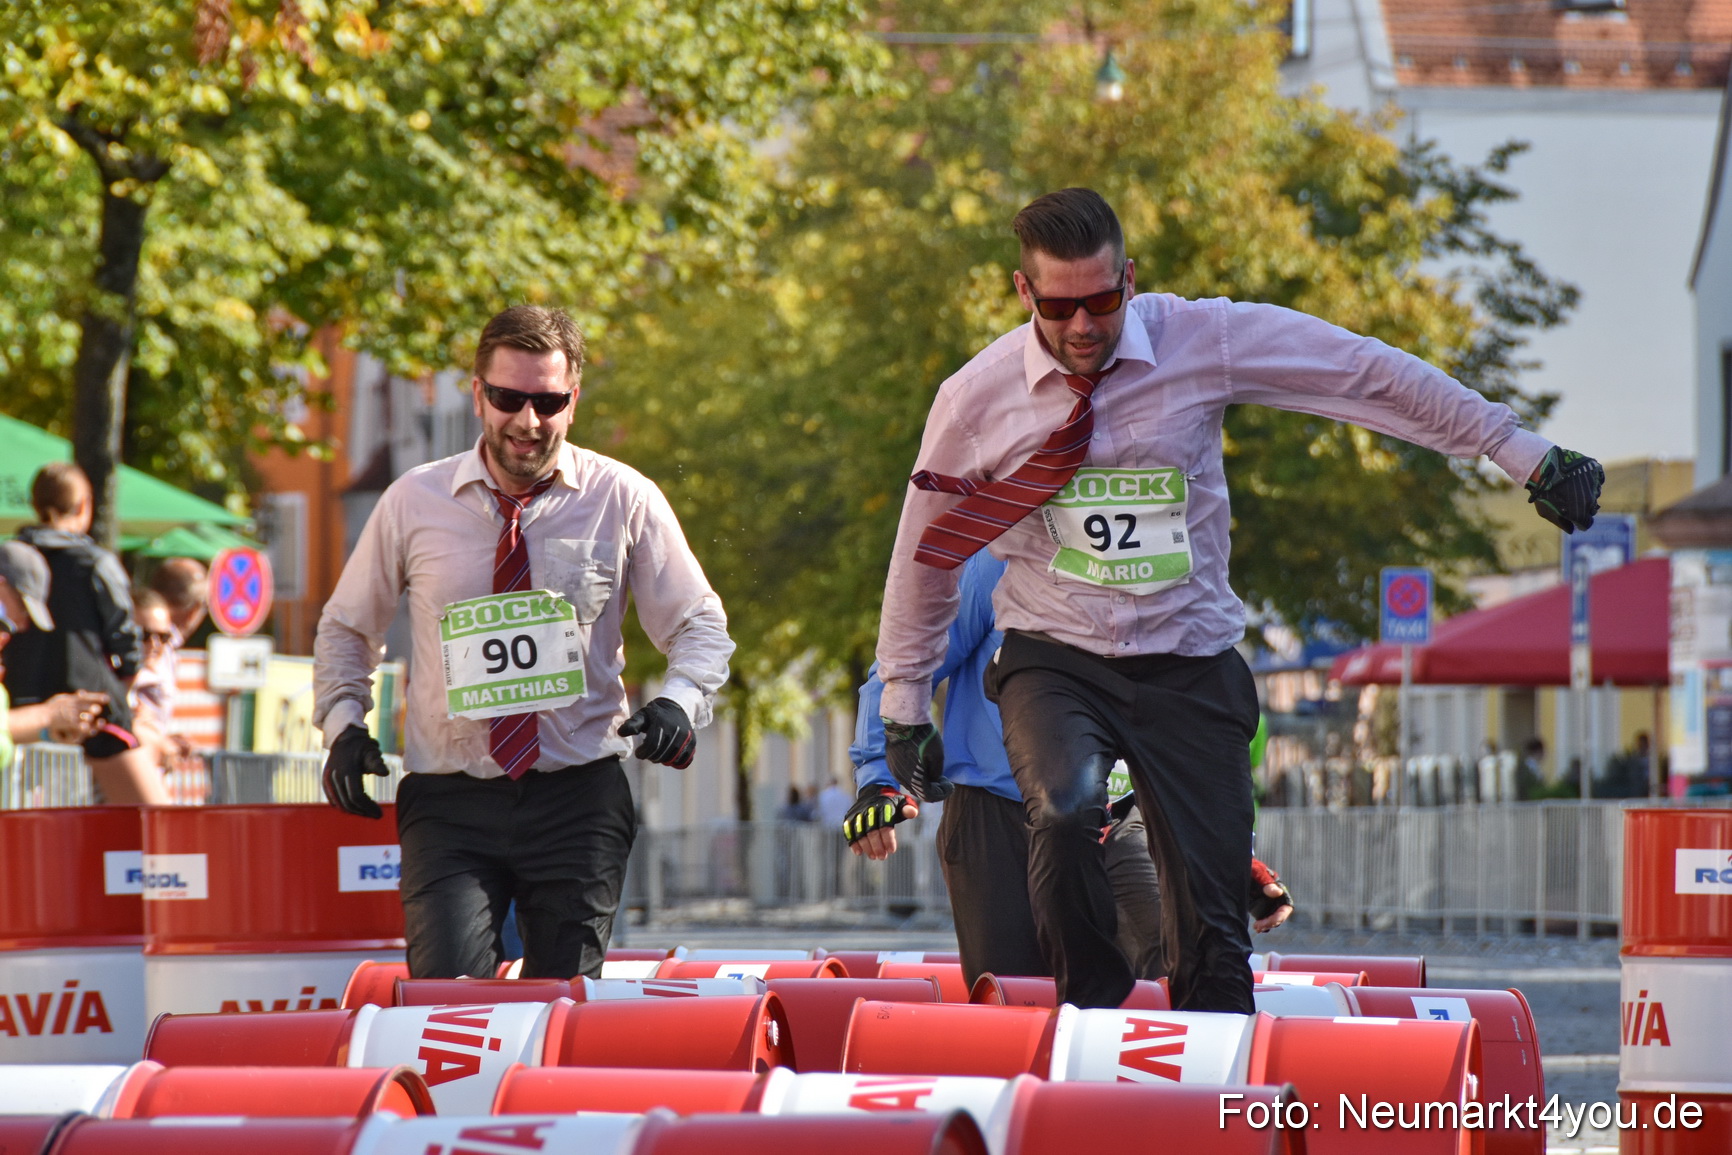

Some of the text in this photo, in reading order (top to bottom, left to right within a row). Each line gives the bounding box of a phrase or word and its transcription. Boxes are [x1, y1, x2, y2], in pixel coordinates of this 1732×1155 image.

[1083, 513, 1141, 552] 92
[1087, 560, 1153, 581] MARIO
[450, 593, 565, 634] BOCK
[1388, 618, 1423, 638] TAXI
[482, 634, 538, 674] 90
[462, 678, 569, 706] MATTHIAS
[359, 864, 402, 880] RO
